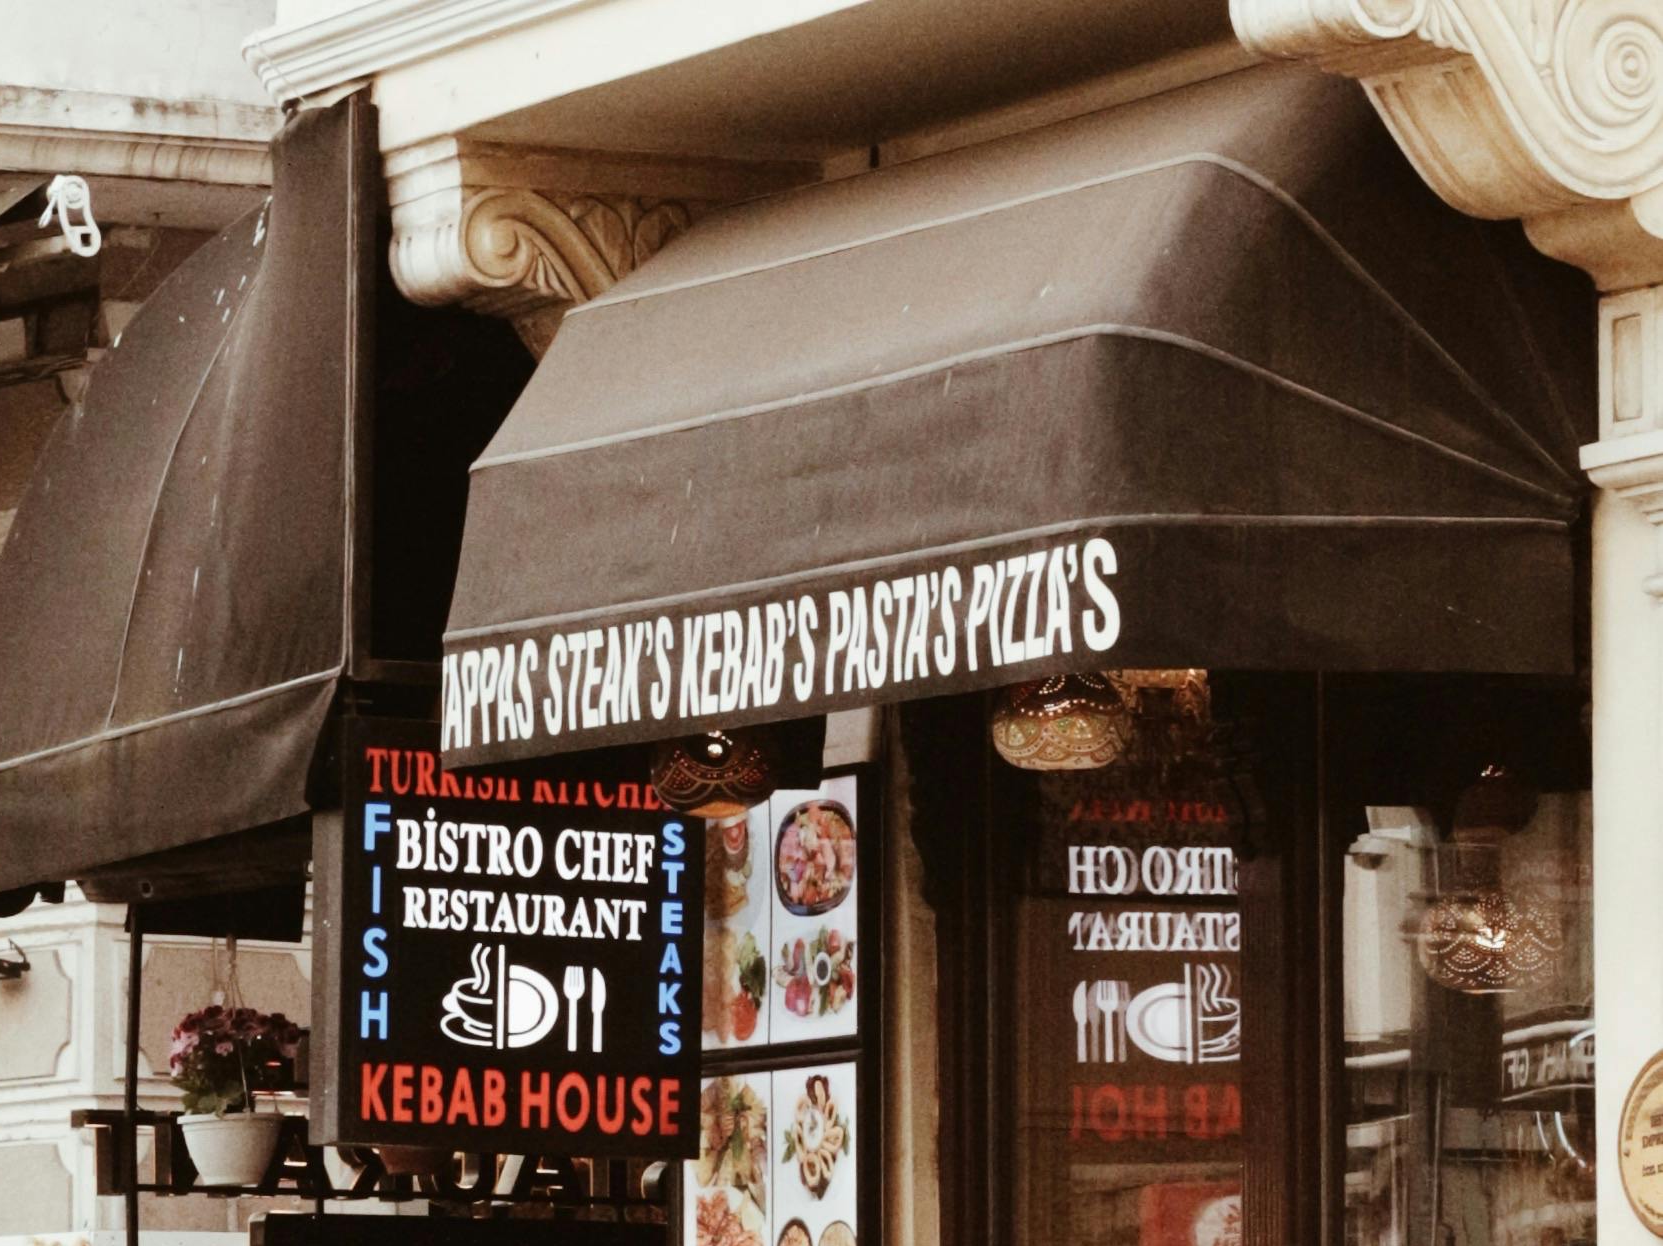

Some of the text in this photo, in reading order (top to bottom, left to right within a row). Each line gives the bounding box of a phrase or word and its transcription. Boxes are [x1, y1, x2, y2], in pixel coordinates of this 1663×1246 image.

[441, 537, 1121, 752] APPAS STEAK'S KEBAB'S PASTA'S PIZZA'S
[362, 803, 392, 1040] FISH
[402, 886, 647, 941] RESTAURANT
[555, 828, 656, 884] CHEF
[658, 823, 685, 1056] STEAKS
[360, 1063, 681, 1136] KEBAB HOUSE
